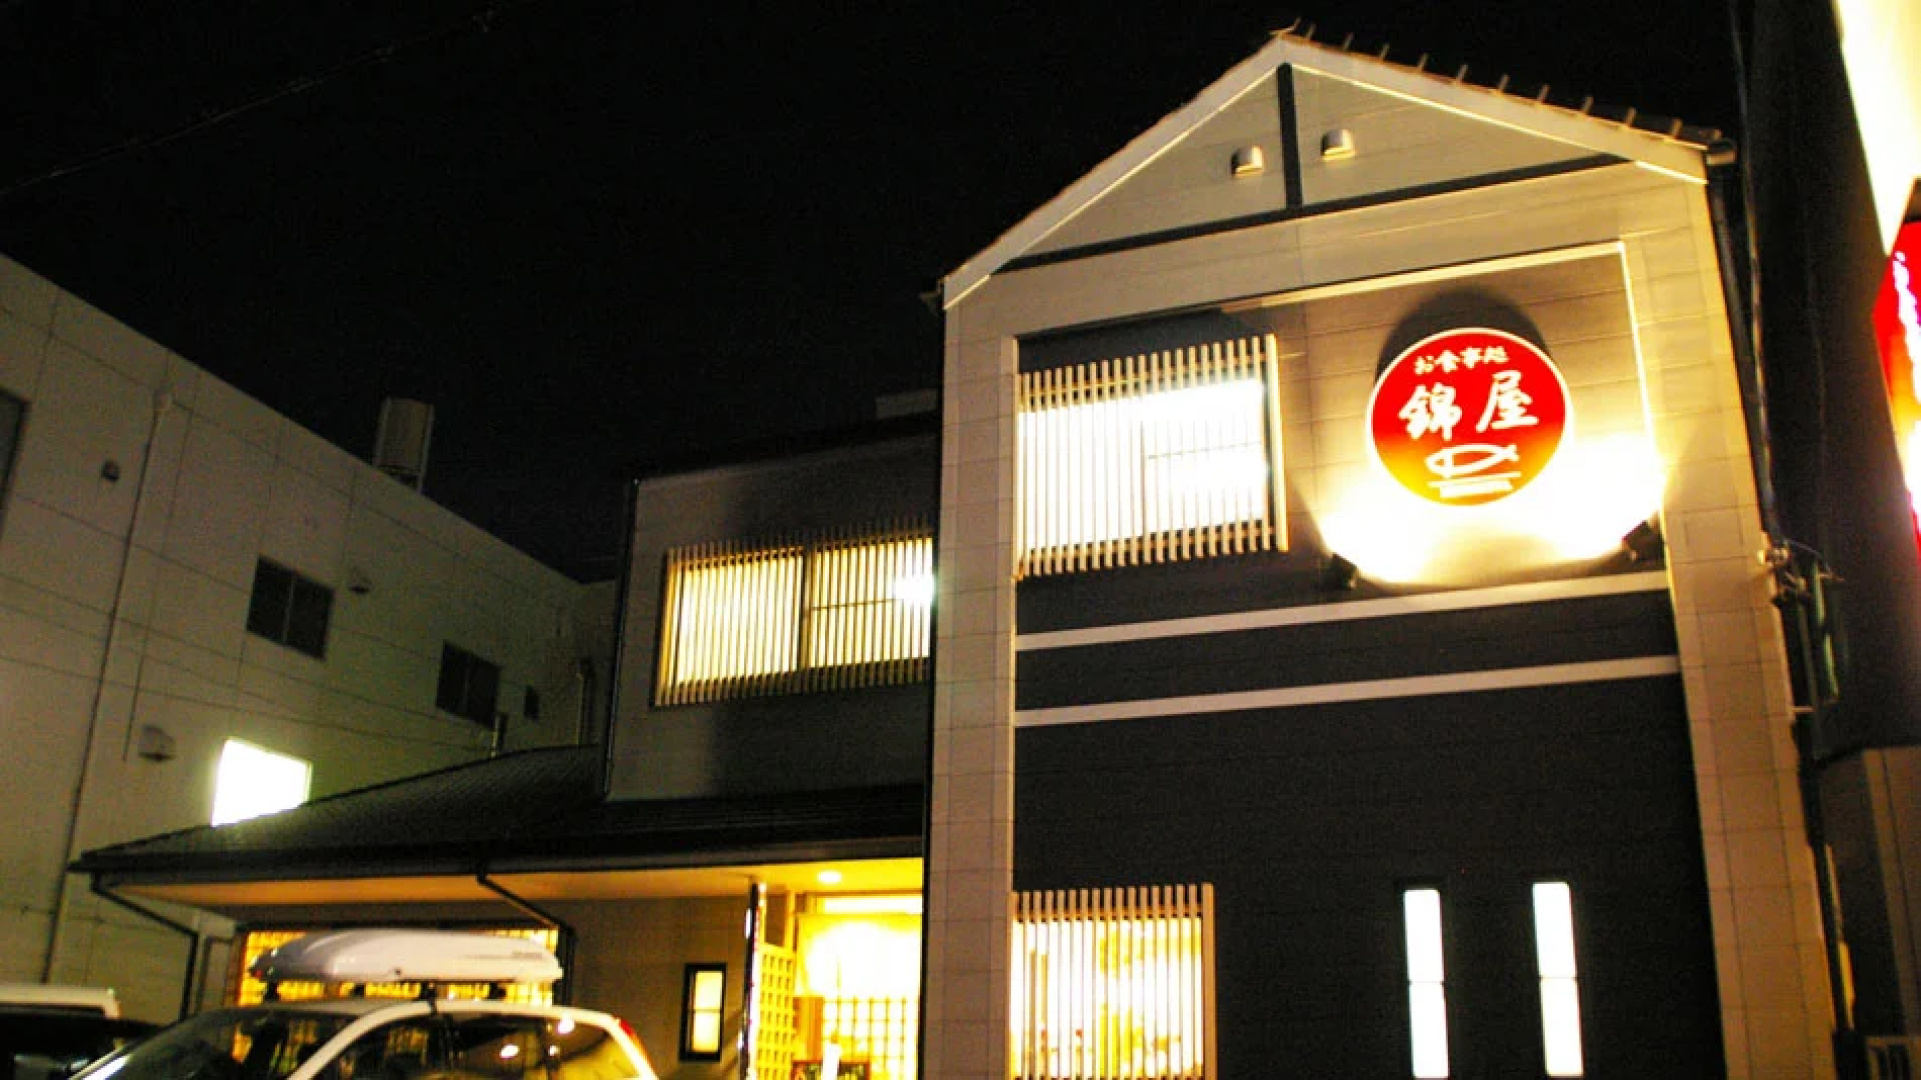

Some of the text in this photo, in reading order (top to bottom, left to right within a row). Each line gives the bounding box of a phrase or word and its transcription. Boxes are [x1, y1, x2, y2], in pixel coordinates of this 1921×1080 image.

[1414, 345, 1509, 376] お食事処
[1398, 369, 1539, 441] 錦屋
